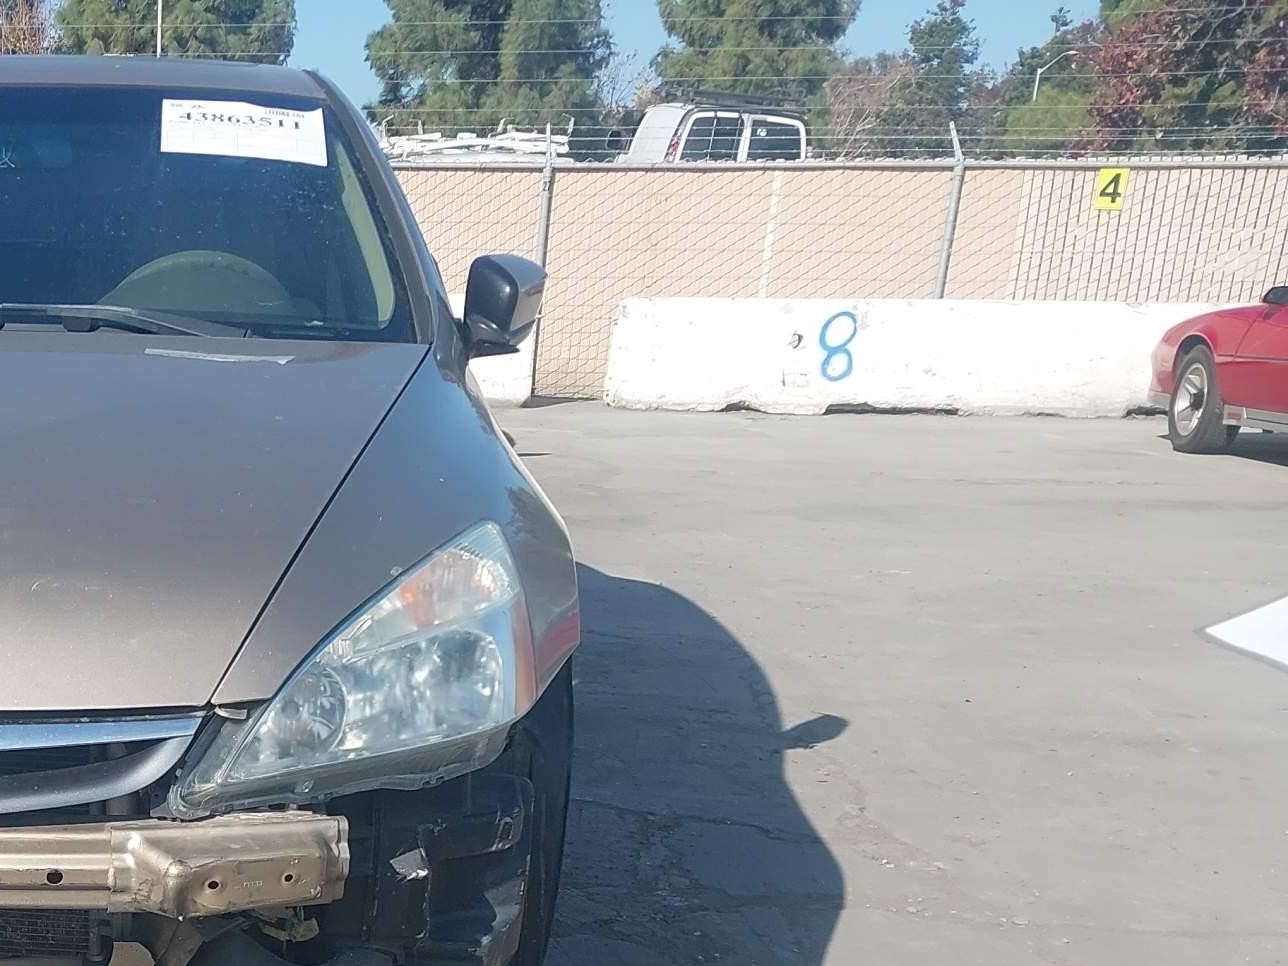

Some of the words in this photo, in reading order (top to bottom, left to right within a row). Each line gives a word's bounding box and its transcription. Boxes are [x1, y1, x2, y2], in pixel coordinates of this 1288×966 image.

[179, 111, 300, 130] 43863511
[1099, 172, 1122, 204] 4
[819, 311, 857, 382] 8
